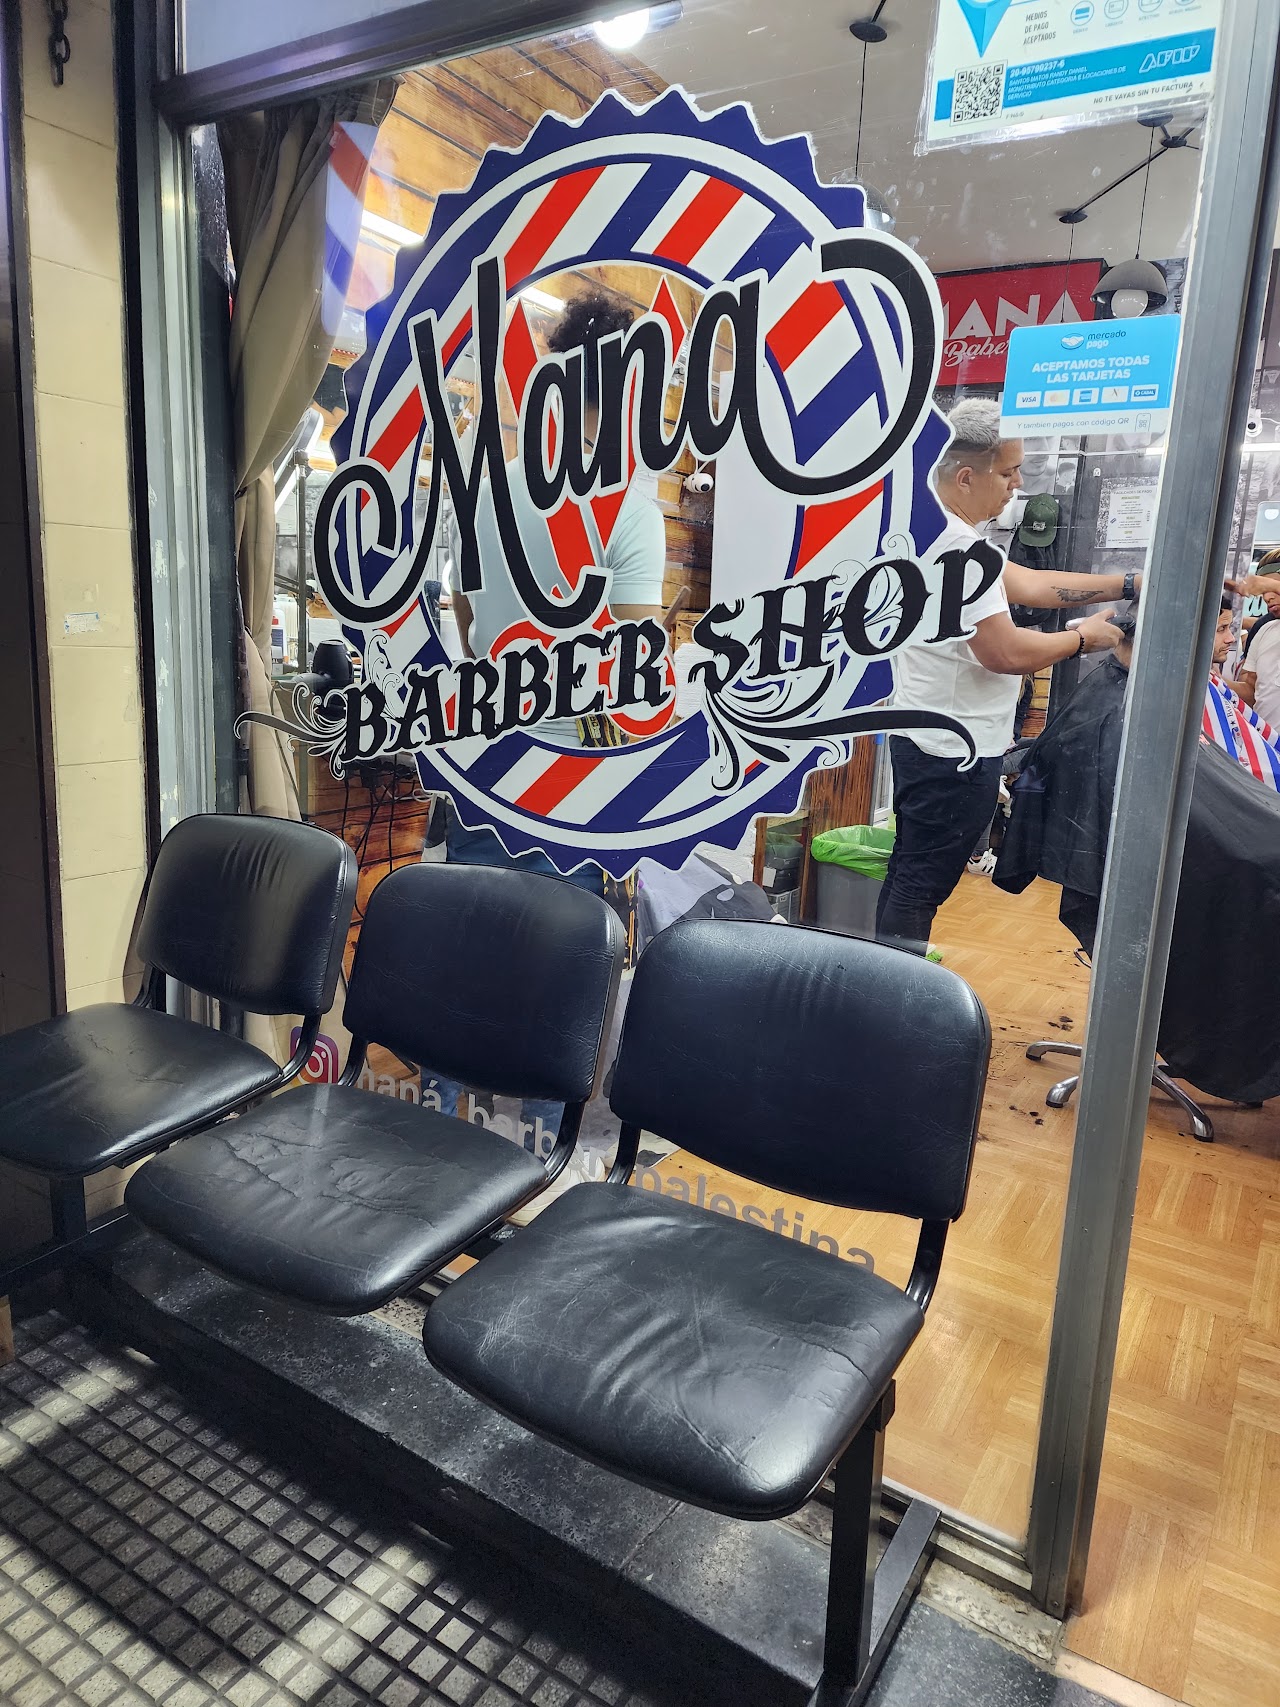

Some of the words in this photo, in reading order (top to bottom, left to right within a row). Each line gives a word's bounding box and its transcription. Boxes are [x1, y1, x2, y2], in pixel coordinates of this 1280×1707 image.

[1026, 11, 1047, 22] MEDIOS
[1025, 25, 1033, 34] DE
[1033, 22, 1049, 32] PAGO
[1023, 32, 1056, 45] ACEPTADOS
[1139, 45, 1200, 74] AFIP
[1030, 73, 1049, 82] MATOS
[1093, 97, 1103, 105] NO
[1114, 91, 1136, 101] VAYAS
[1137, 89, 1149, 97] SIN
[1161, 81, 1193, 92] FACTURA
[943, 290, 1082, 340] ANA
[1087, 330, 1126, 340] mercado
[943, 337, 1010, 367] Babe
[1086, 340, 1109, 350] pago
[1032, 358, 1105, 373] ACEPTAMOS
[1109, 355, 1150, 367] TODAS
[1047, 373, 1068, 384] LAS
[1072, 369, 1131, 382] TARJETAS
[1053, 421, 1074, 430] pagos
[340, 620, 675, 762] BARBER
[691, 537, 1006, 697] SHOP
